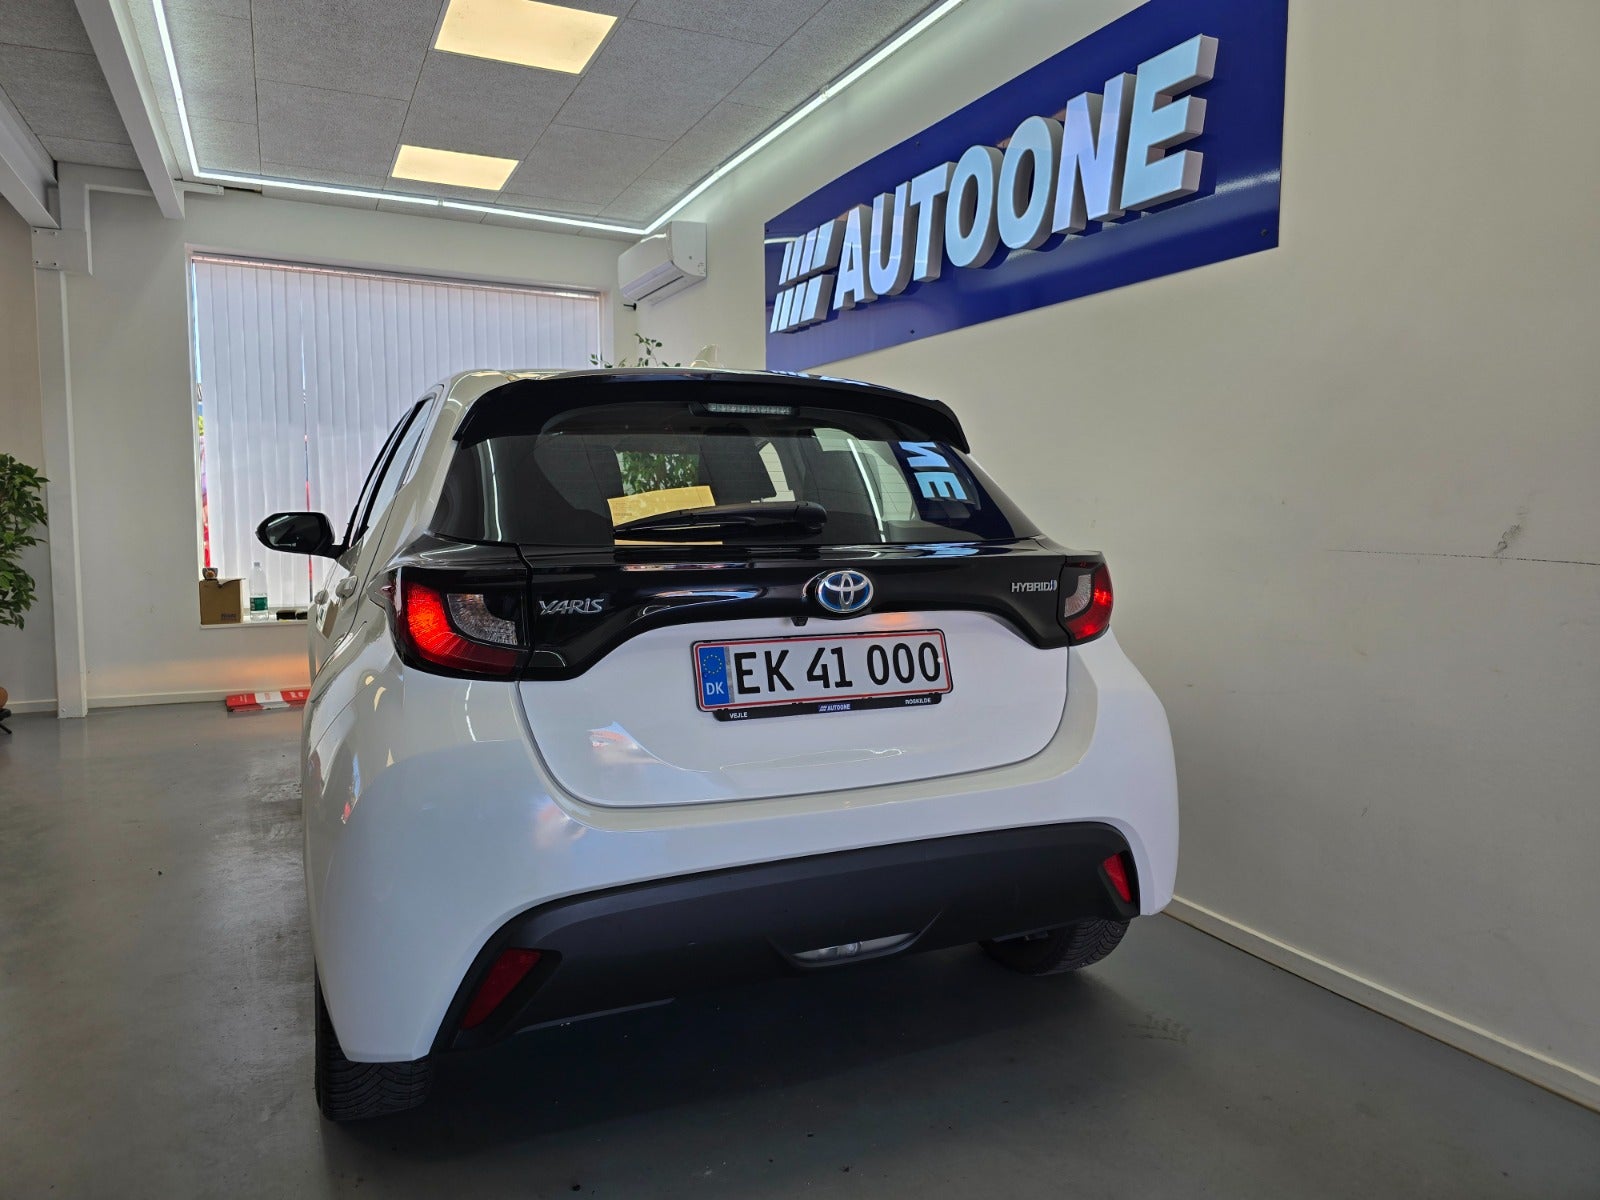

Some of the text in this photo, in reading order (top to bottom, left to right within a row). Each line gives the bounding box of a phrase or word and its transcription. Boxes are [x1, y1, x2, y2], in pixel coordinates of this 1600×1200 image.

[833, 34, 1218, 310] AUTOONE
[1011, 582, 1051, 593] HYBRID
[539, 598, 605, 615] YARIS
[734, 642, 941, 695] EK 41 000
[705, 682, 725, 695] DK
[729, 711, 748, 719] VEJLE
